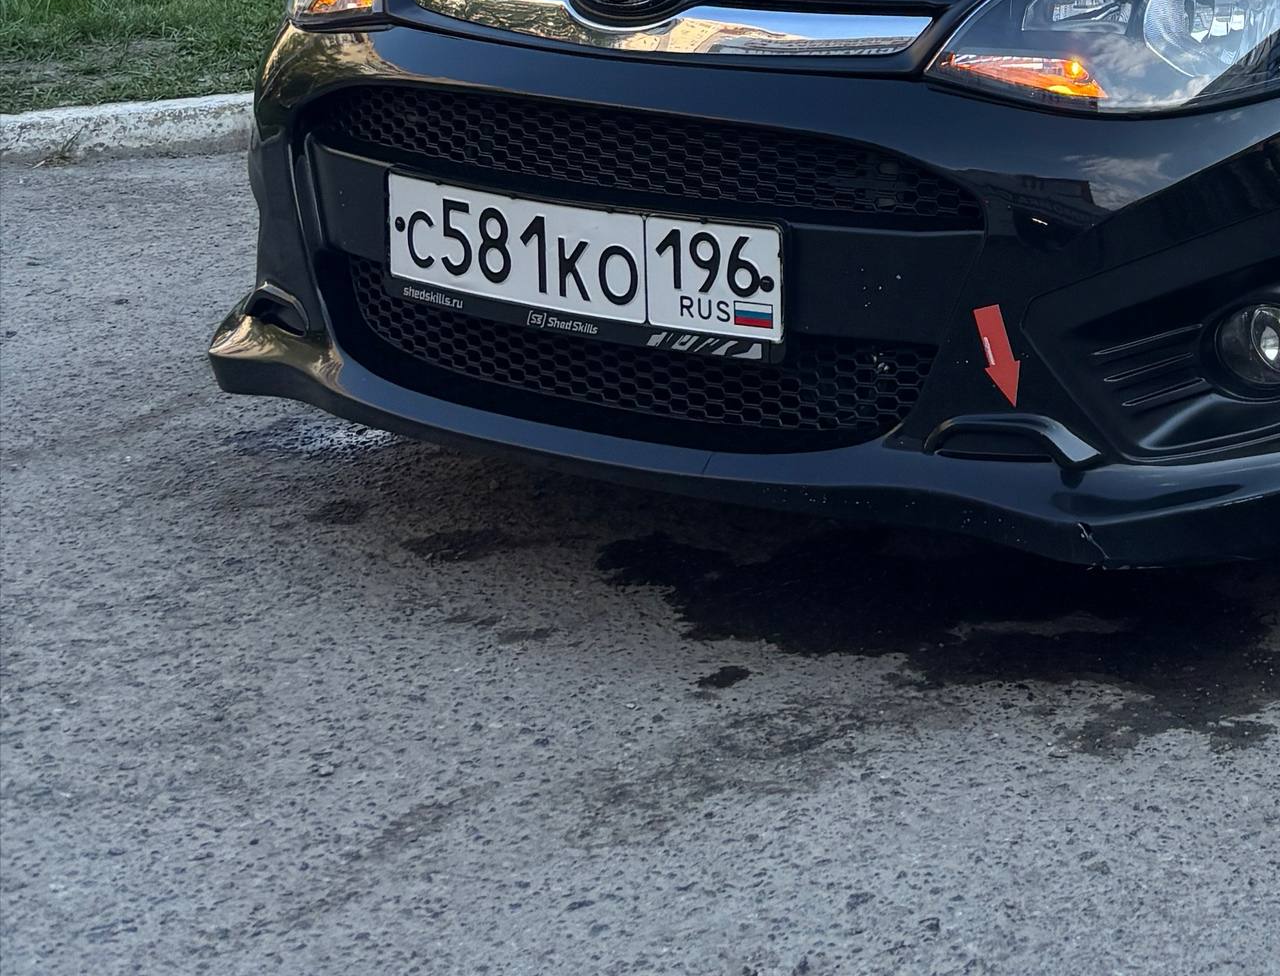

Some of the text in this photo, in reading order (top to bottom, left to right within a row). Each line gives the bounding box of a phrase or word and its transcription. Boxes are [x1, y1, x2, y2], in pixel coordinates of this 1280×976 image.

[655, 229, 761, 298] 196
[403, 286, 463, 309] shedskills.ru
[679, 295, 731, 323] RUS
[547, 317, 572, 330] Shed
[572, 321, 598, 334] Skills
